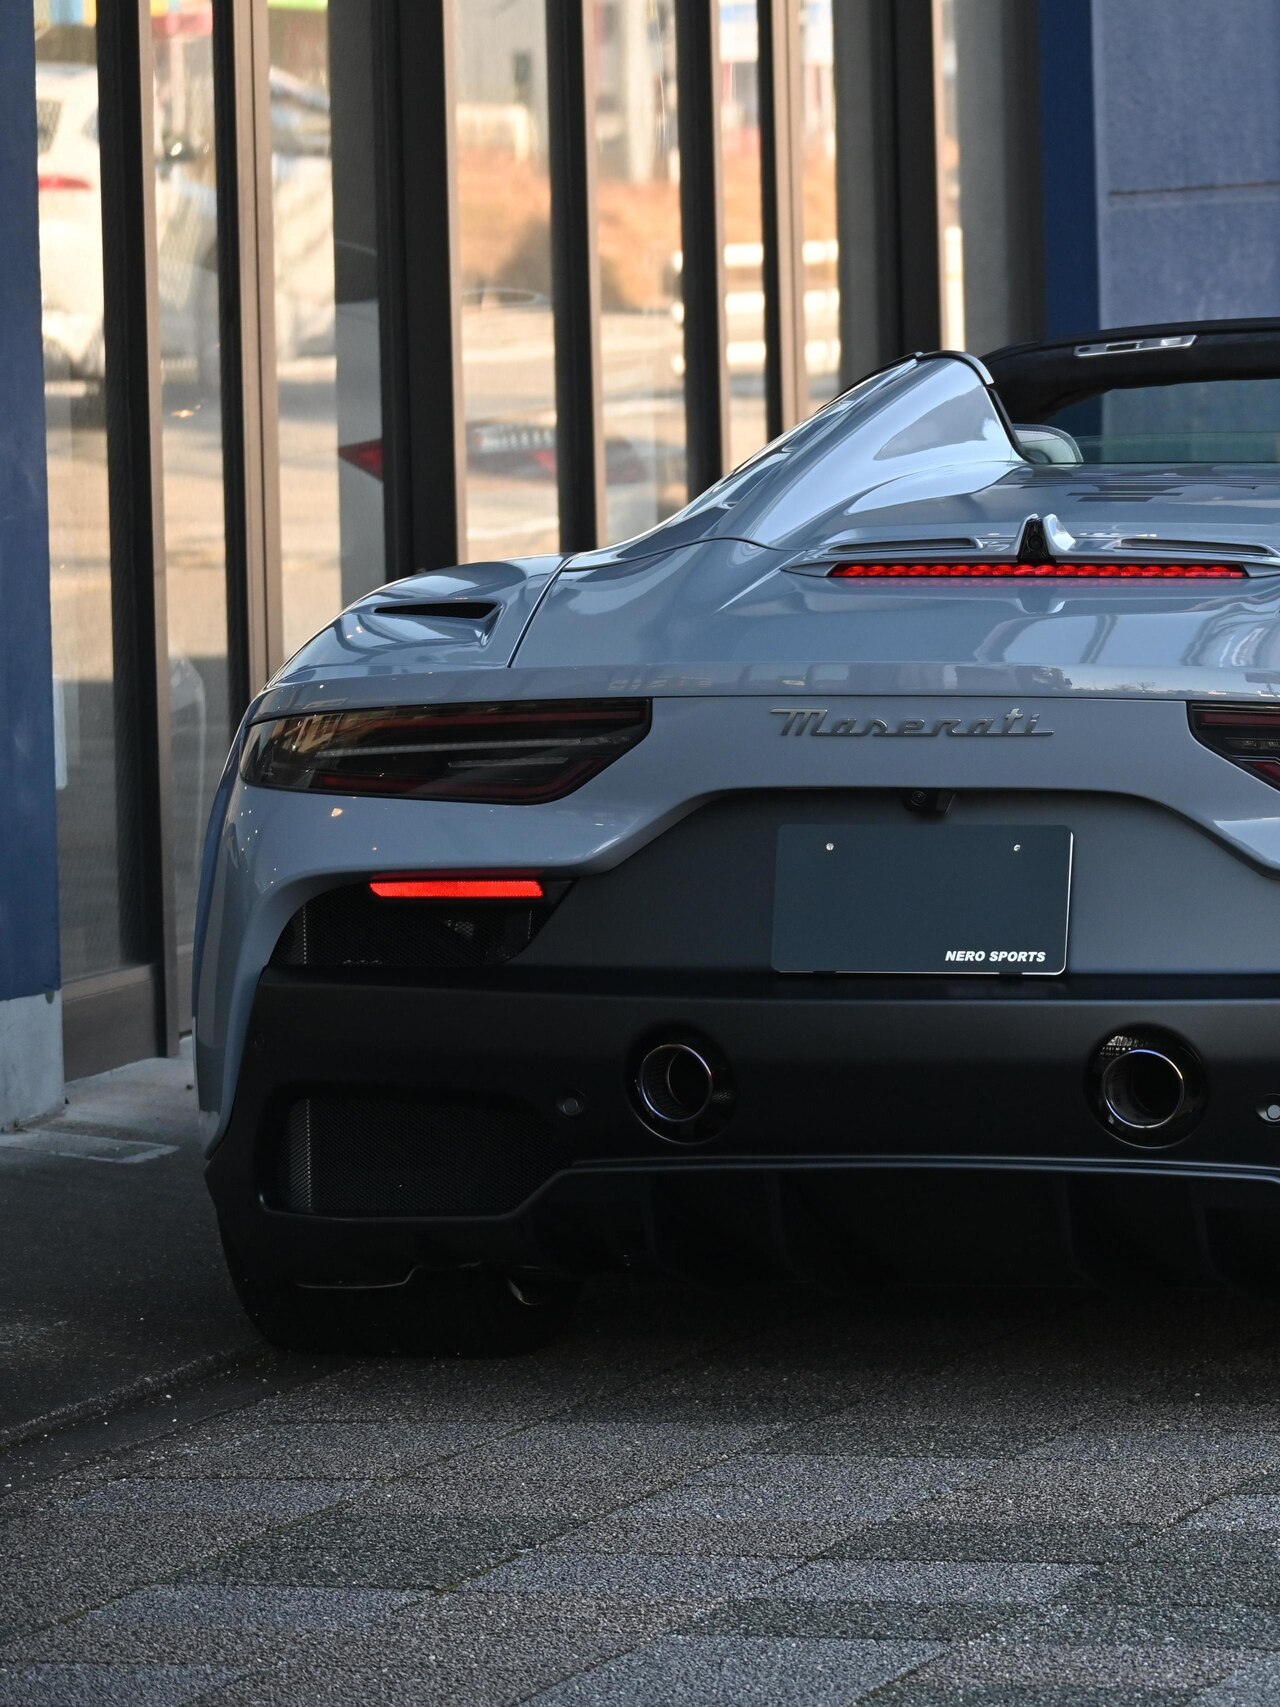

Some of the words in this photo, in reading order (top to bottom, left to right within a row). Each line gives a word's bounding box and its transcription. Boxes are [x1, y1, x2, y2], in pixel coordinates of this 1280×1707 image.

[769, 707, 1055, 737] Maserati
[945, 951, 985, 961] NERO
[988, 951, 1046, 962] SPORTS
